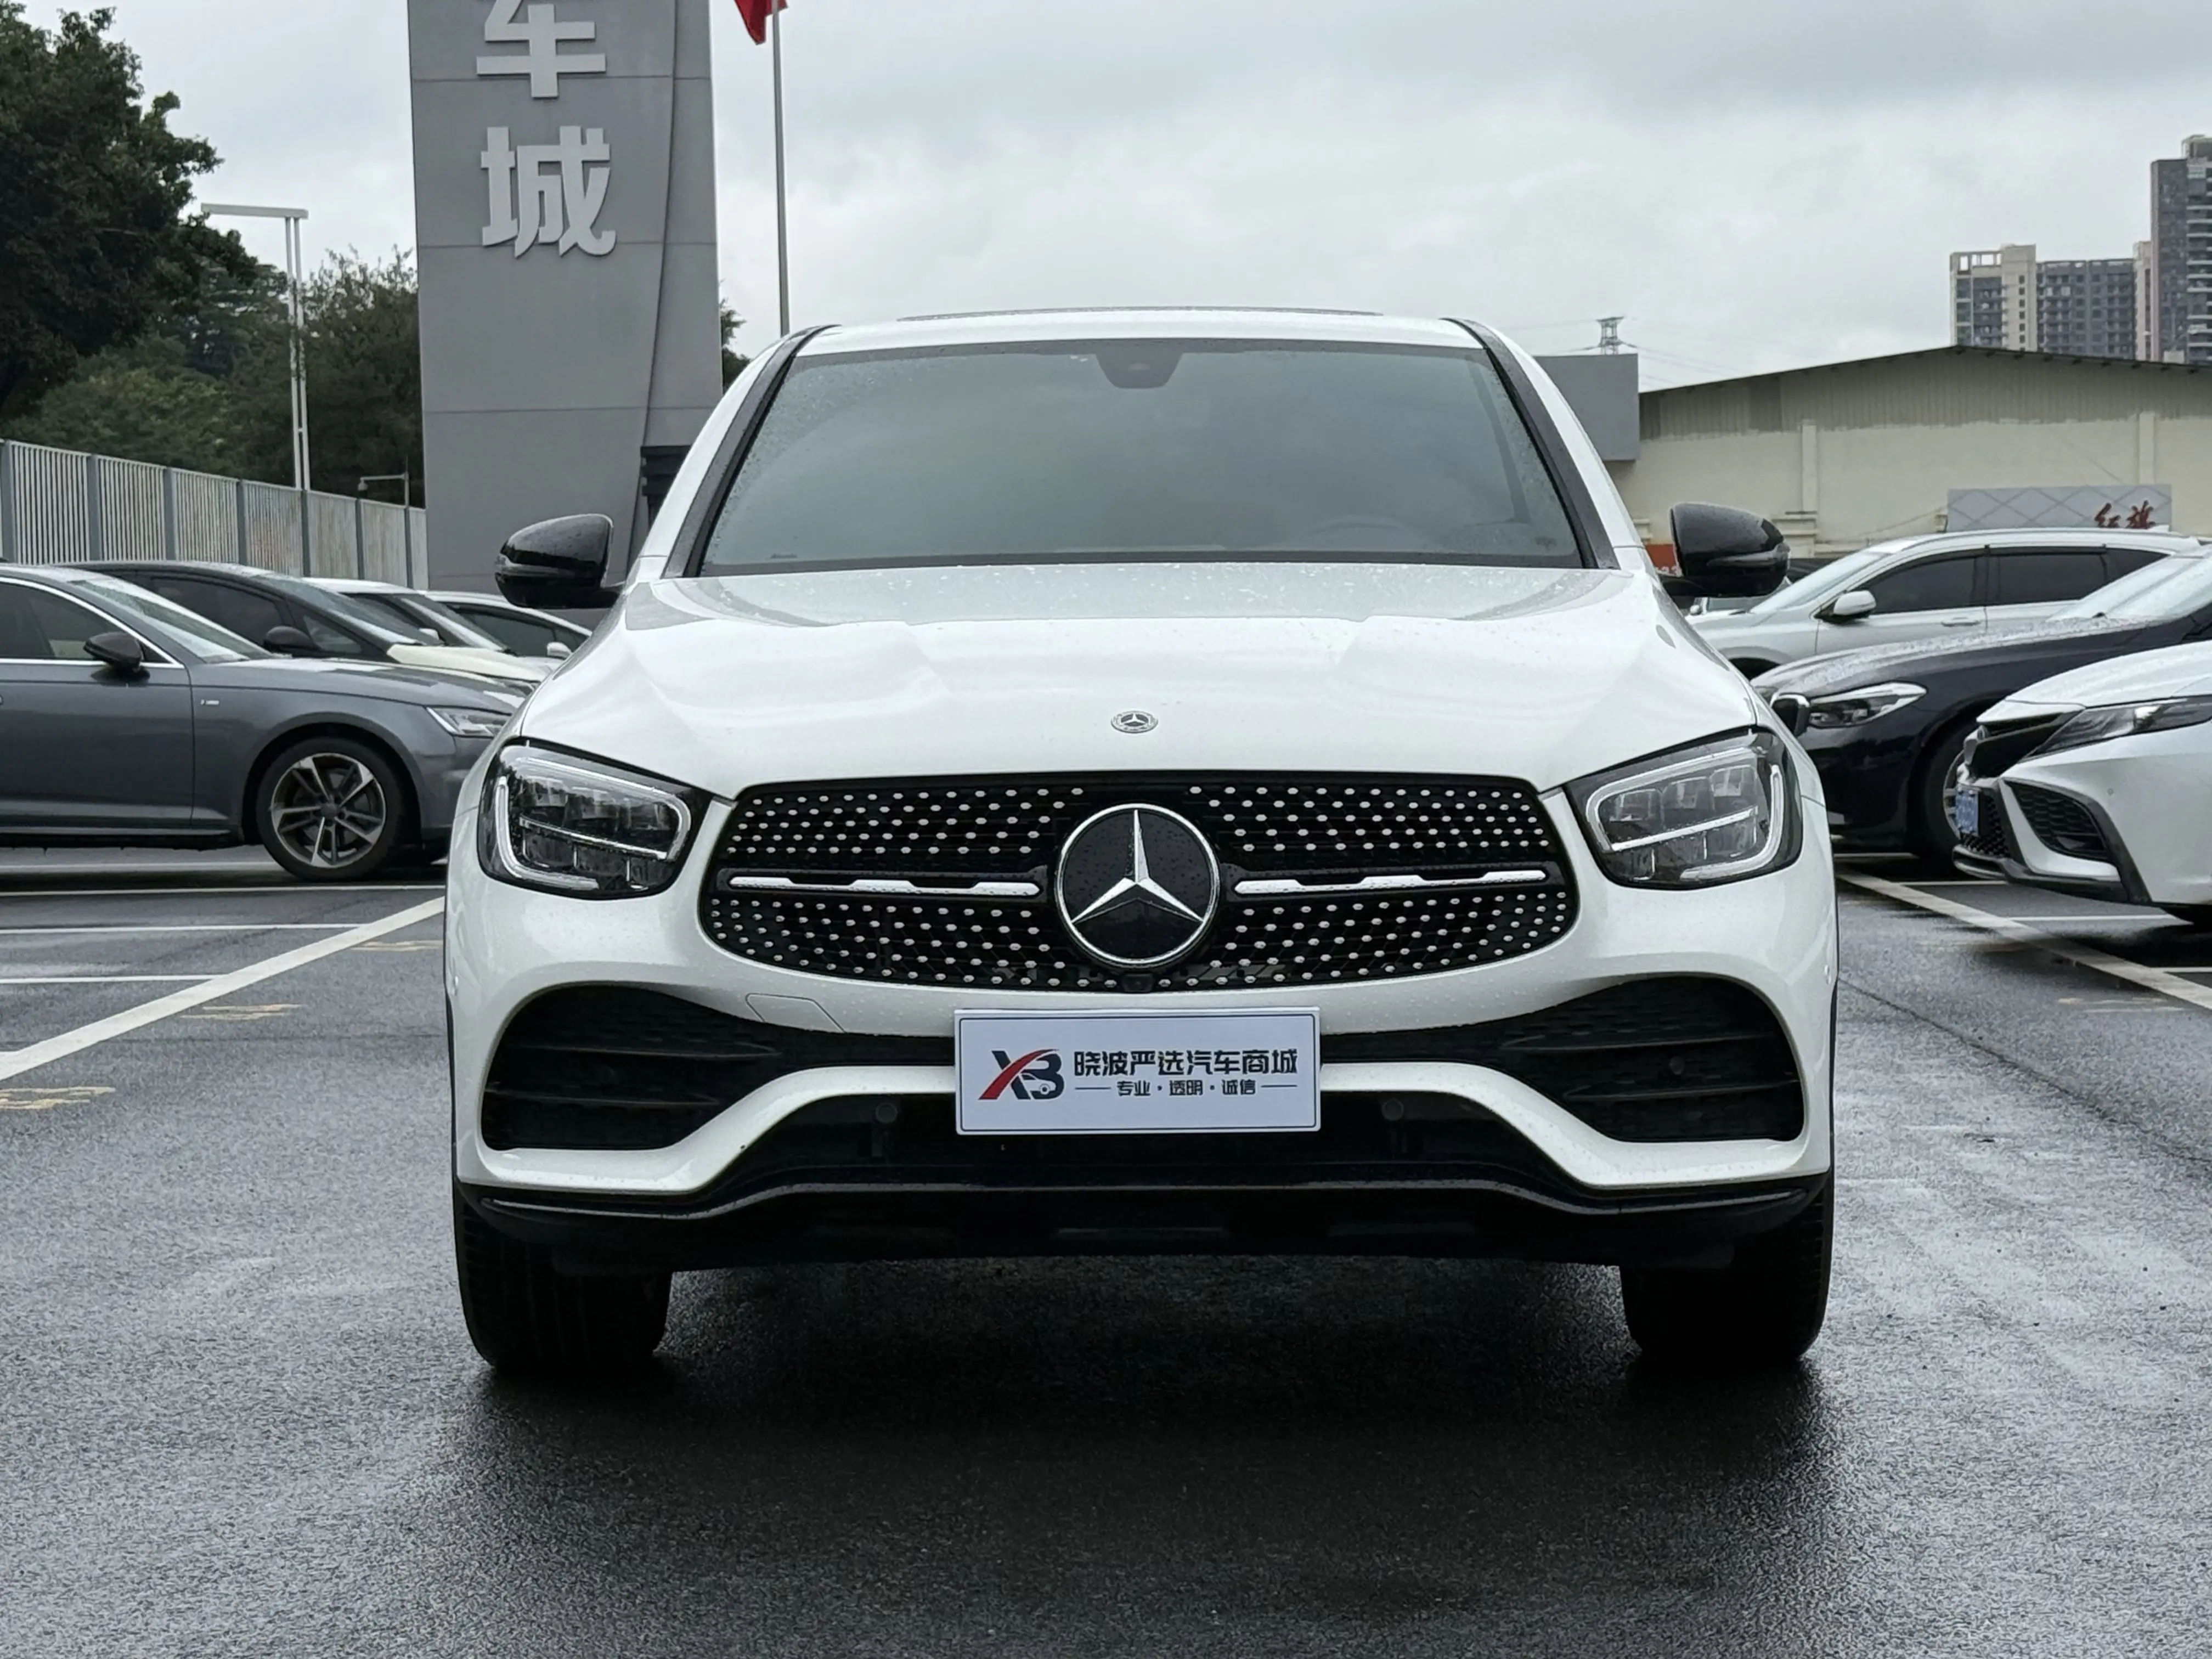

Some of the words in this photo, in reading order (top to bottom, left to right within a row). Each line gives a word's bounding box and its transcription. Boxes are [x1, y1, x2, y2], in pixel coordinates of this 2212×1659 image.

[1074, 1048, 1298, 1076] 晓波严选汽车商城
